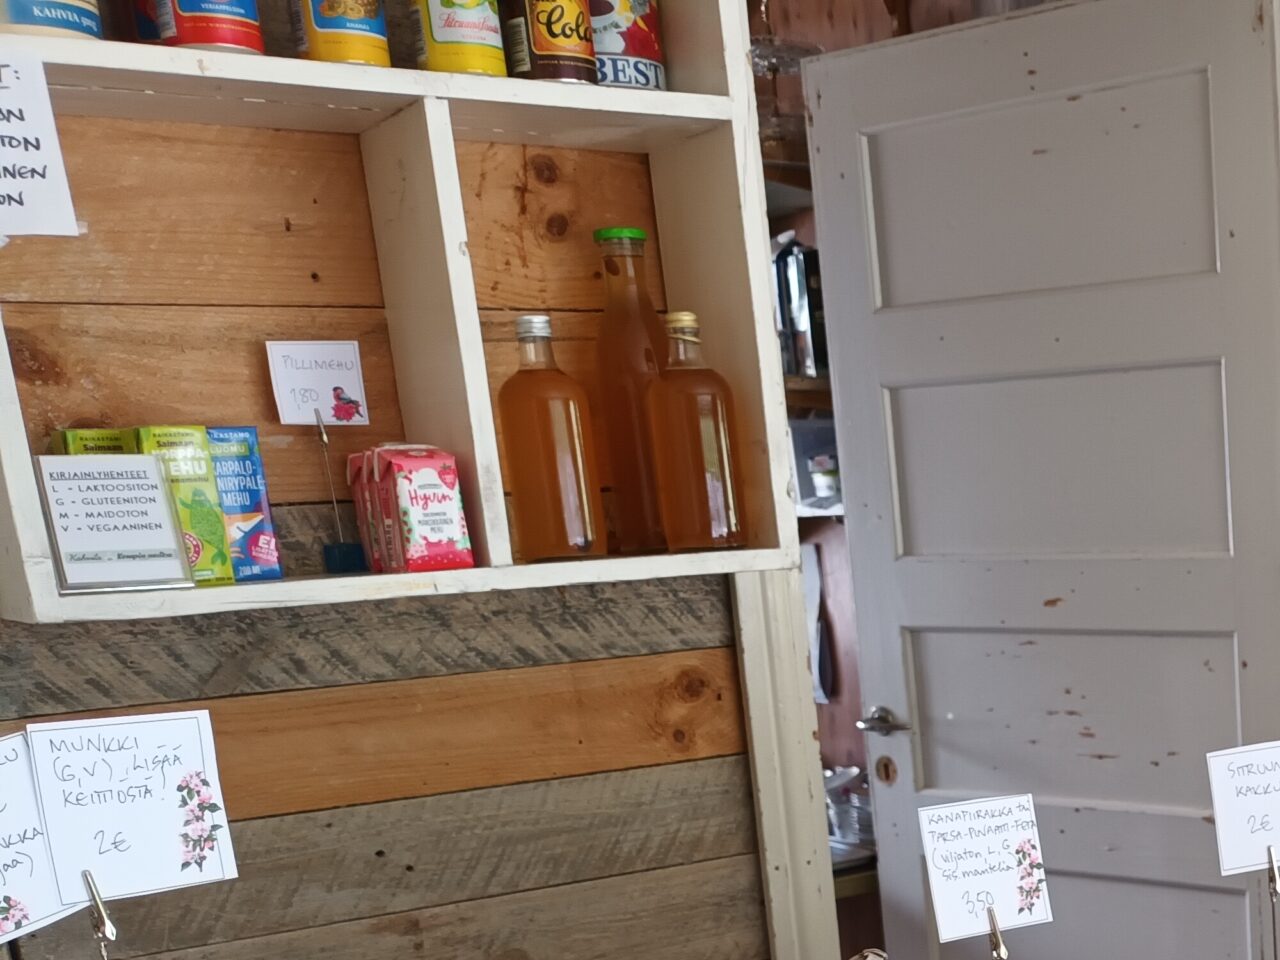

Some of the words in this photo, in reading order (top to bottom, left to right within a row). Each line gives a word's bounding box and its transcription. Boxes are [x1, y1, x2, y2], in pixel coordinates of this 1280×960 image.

[214, 460, 257, 475] ARPALO-
[78, 483, 159, 493] LAKTOOSITON
[56, 498, 65, 506] G
[81, 496, 157, 506] GLUTEENITON
[222, 491, 250, 506] MEHU
[59, 511, 69, 519] M
[85, 510, 149, 519] MAIDOTON
[87, 522, 163, 533] VEGAANINEN
[49, 734, 139, 754] MUNKKI
[927, 805, 1014, 826] KANAPIIRAKKA
[1247, 814, 1273, 834] 2€
[93, 830, 132, 855] 2€
[963, 860, 1015, 879] mantelia
[961, 890, 995, 918] 3,50
